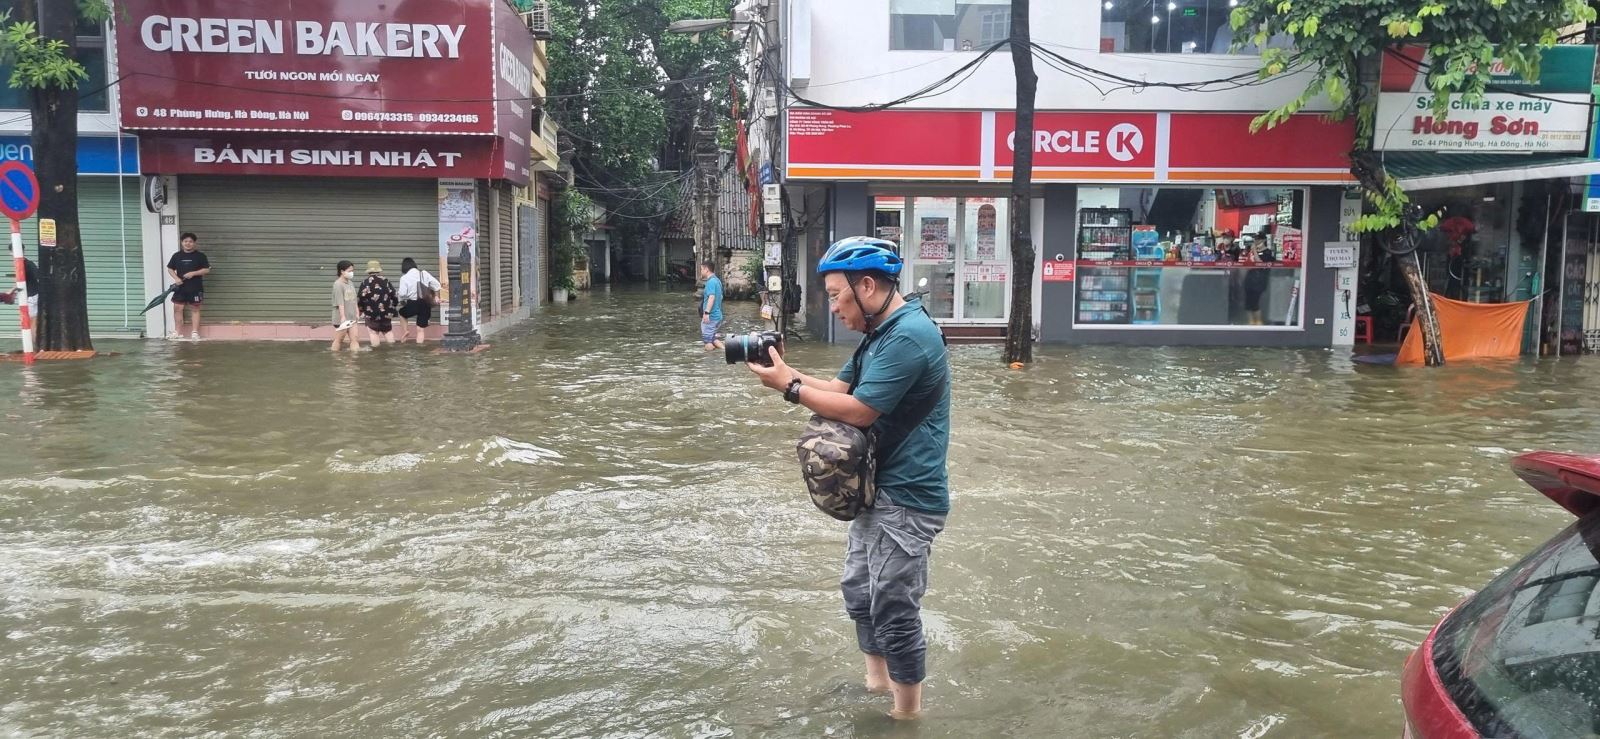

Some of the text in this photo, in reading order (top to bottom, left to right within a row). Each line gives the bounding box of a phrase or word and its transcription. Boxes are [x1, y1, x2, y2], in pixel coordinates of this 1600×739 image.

[140, 14, 467, 59] GREEN BAKERY
[280, 72, 317, 81] NGON
[153, 108, 167, 117] 48
[1495, 101, 1515, 111] xe
[1490, 115, 1539, 136] Sơn
[1007, 130, 1100, 153] RCLE
[1427, 139, 1437, 147] 44
[0, 144, 34, 160] en
[194, 143, 462, 168] BÁNH SINH NHẬT
